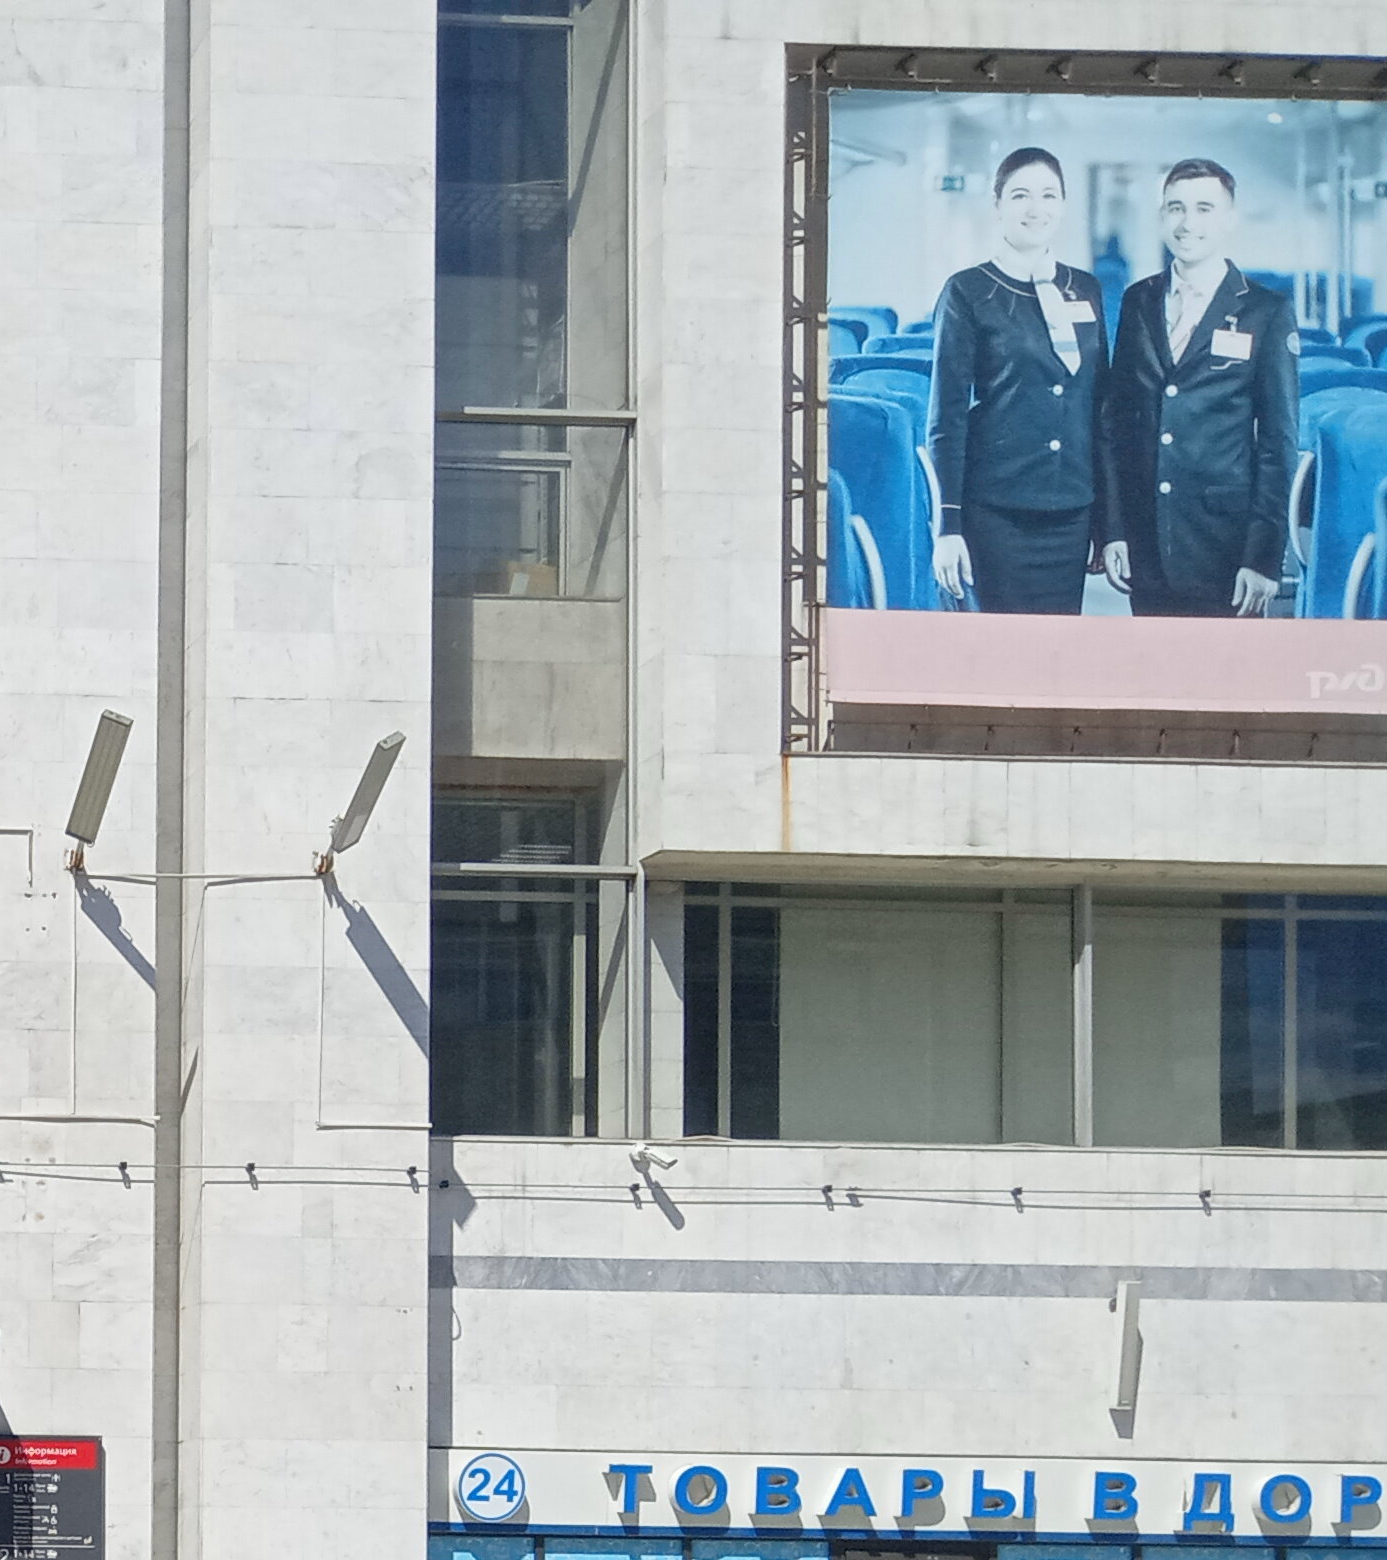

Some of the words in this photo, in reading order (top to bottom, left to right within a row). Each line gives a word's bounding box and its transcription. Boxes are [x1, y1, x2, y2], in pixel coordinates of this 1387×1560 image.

[14, 1446, 77, 1458] Информация
[466, 1468, 519, 1503] 24
[609, 1463, 1036, 1520] ТОВАРЫ
[1092, 1470, 1138, 1521] В
